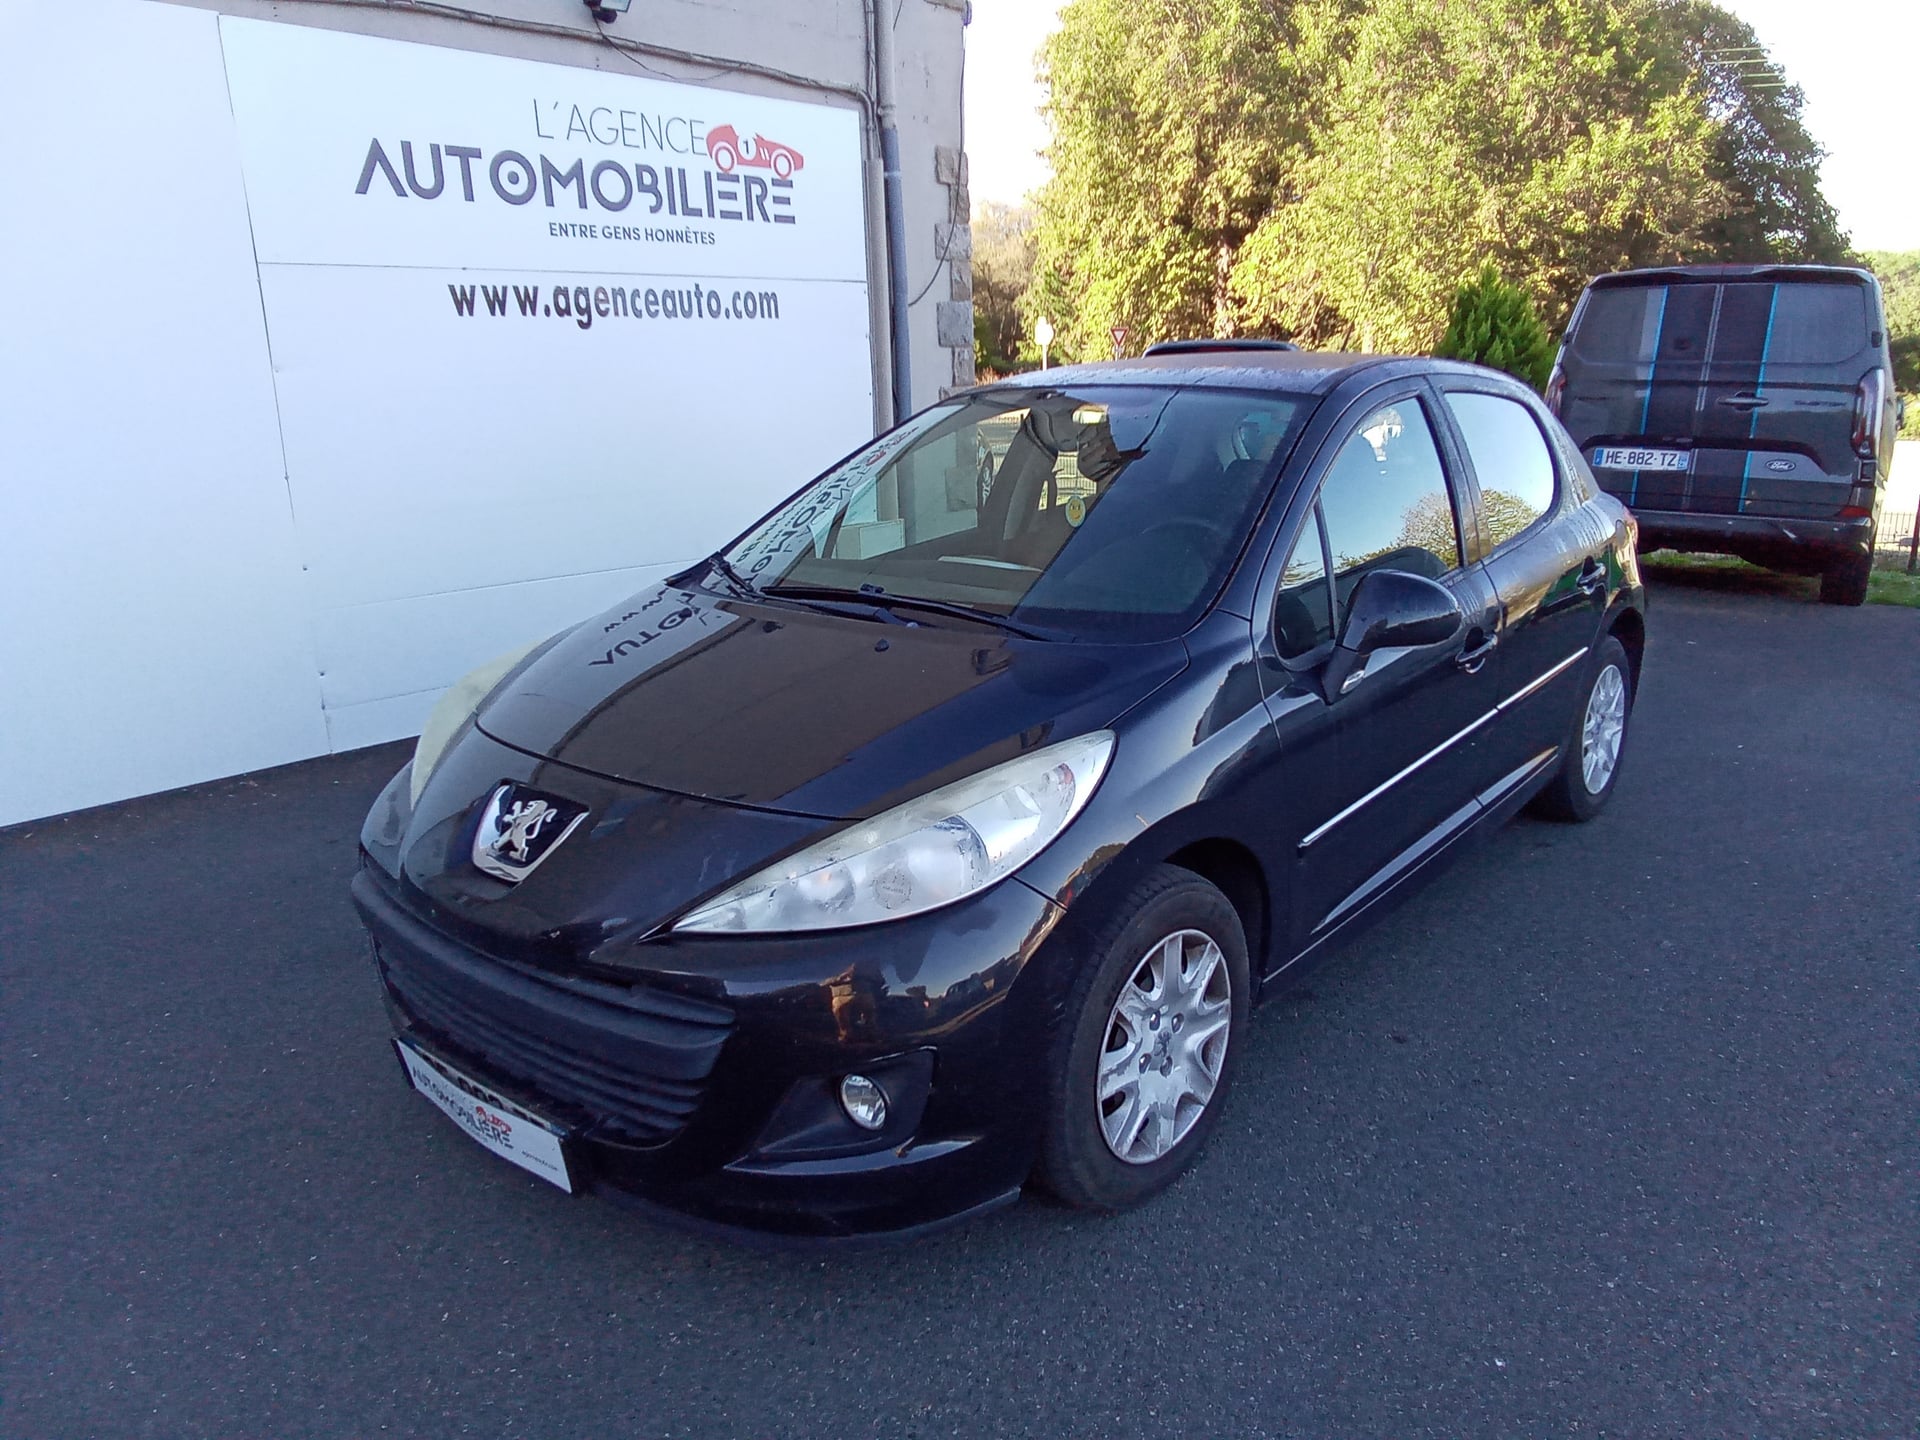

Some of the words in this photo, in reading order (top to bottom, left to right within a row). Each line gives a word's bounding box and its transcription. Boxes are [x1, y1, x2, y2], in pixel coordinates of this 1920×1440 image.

[533, 98, 707, 156] L'AGENCE
[549, 222, 598, 239] ENTRE
[601, 225, 641, 241] GENS
[645, 226, 716, 245] HONNÊTES
[448, 283, 780, 330] www.agenceauto.com
[1605, 450, 1677, 467] HE-882-TZ
